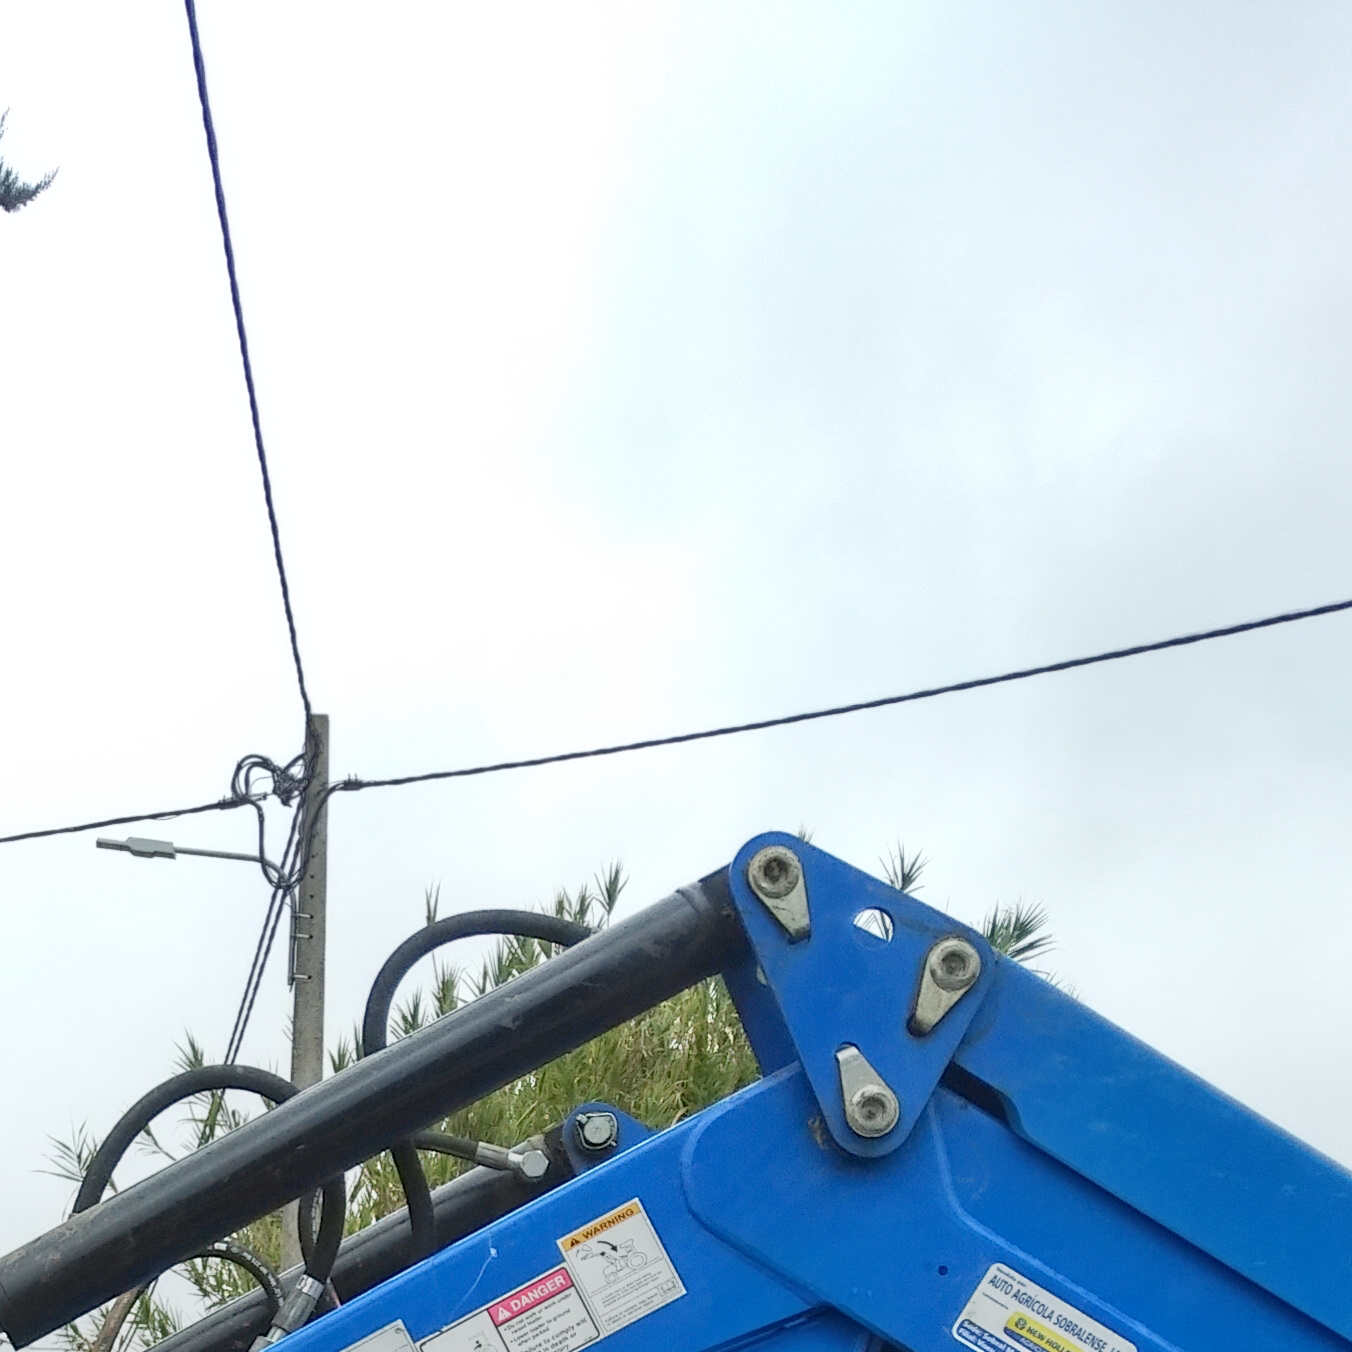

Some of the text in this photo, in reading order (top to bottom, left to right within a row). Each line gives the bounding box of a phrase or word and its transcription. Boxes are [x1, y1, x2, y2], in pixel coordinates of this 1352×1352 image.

[582, 1208, 634, 1239] WARNING
[509, 1275, 566, 1312] DANGER
[988, 1274, 1014, 1295] AUTO
[1010, 1289, 1055, 1322] AGRÍCOLA
[1026, 1326, 1045, 1341] NEW
